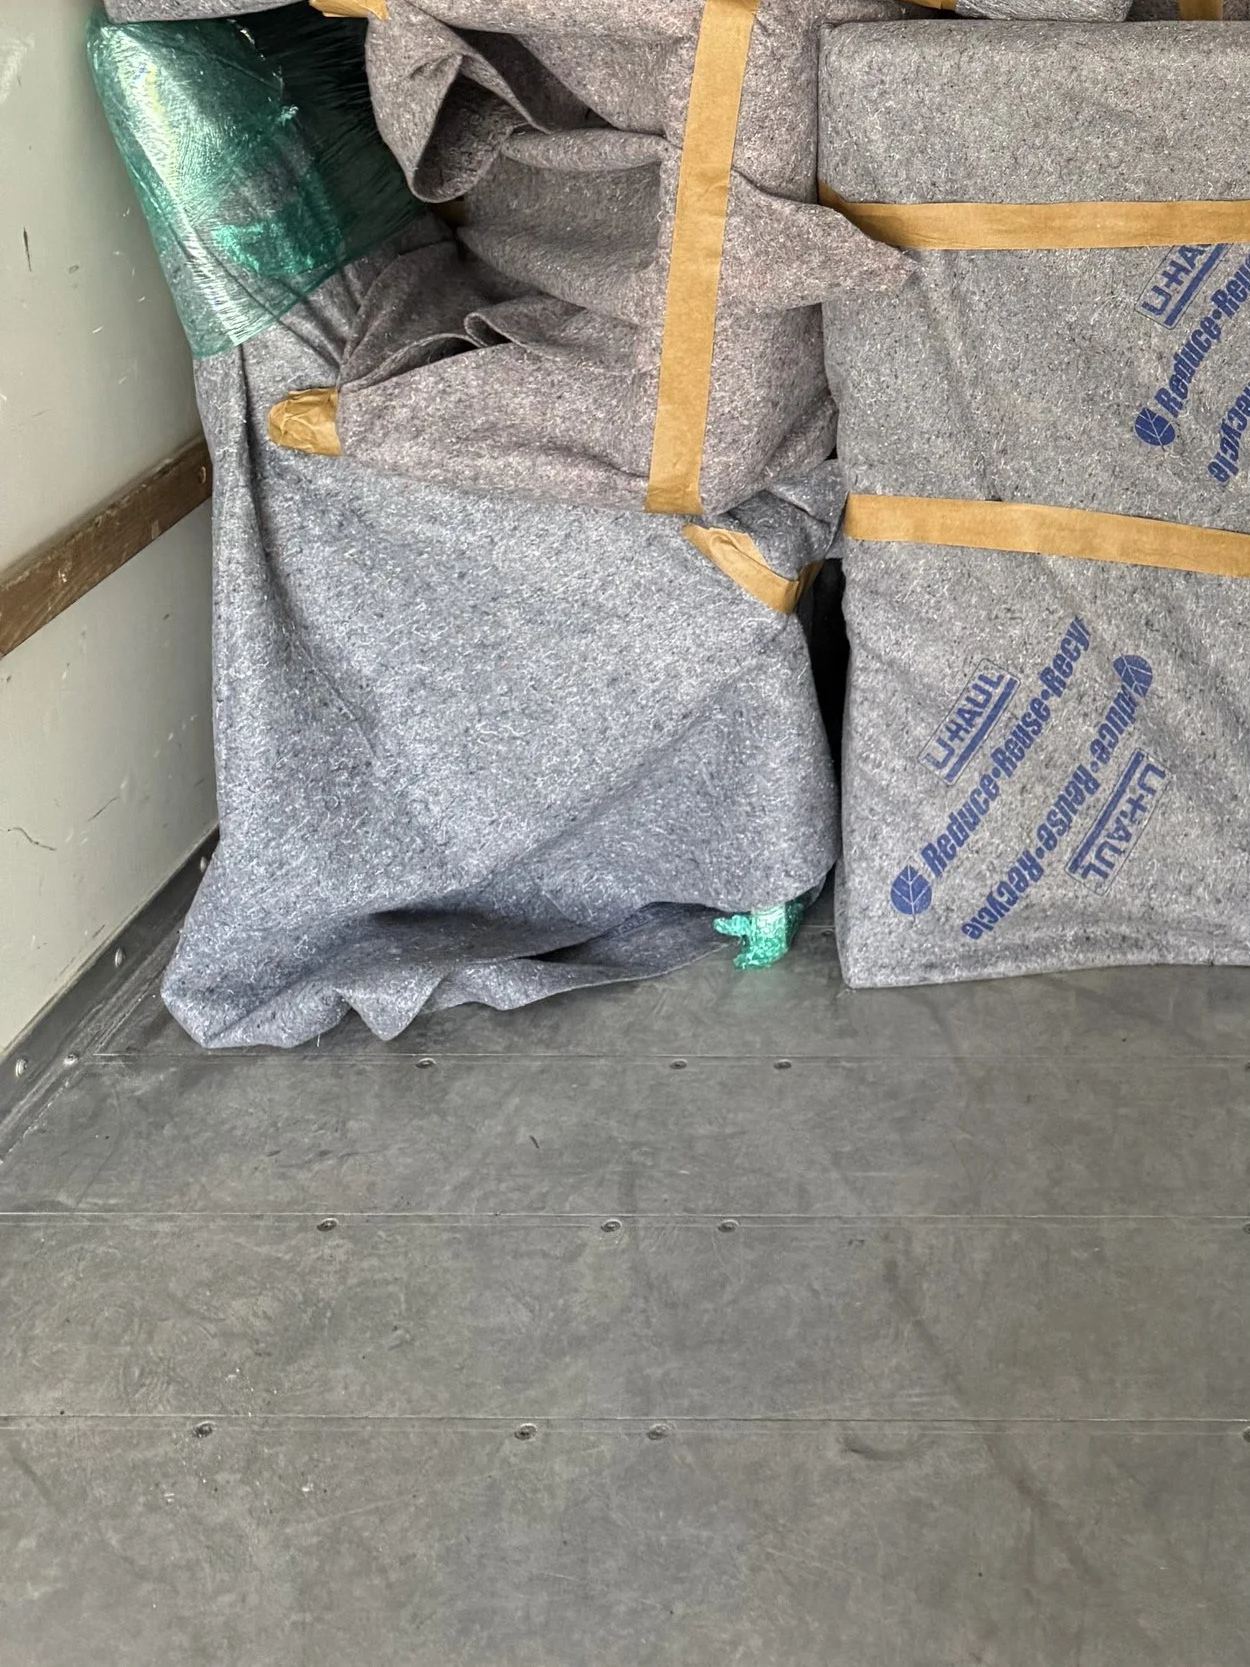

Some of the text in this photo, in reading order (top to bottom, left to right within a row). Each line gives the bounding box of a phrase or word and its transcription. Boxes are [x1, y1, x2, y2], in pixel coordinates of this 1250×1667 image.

[1141, 244, 1211, 316] U-HA
[1154, 319, 1222, 419] Reduce
[920, 616, 1091, 879] Reduce Reuse Recy
[923, 673, 1004, 770] U-HAUL
[1036, 764, 1100, 852] Reuse
[1081, 763, 1167, 880] U-HAUL
[961, 850, 1044, 940] Recycle
